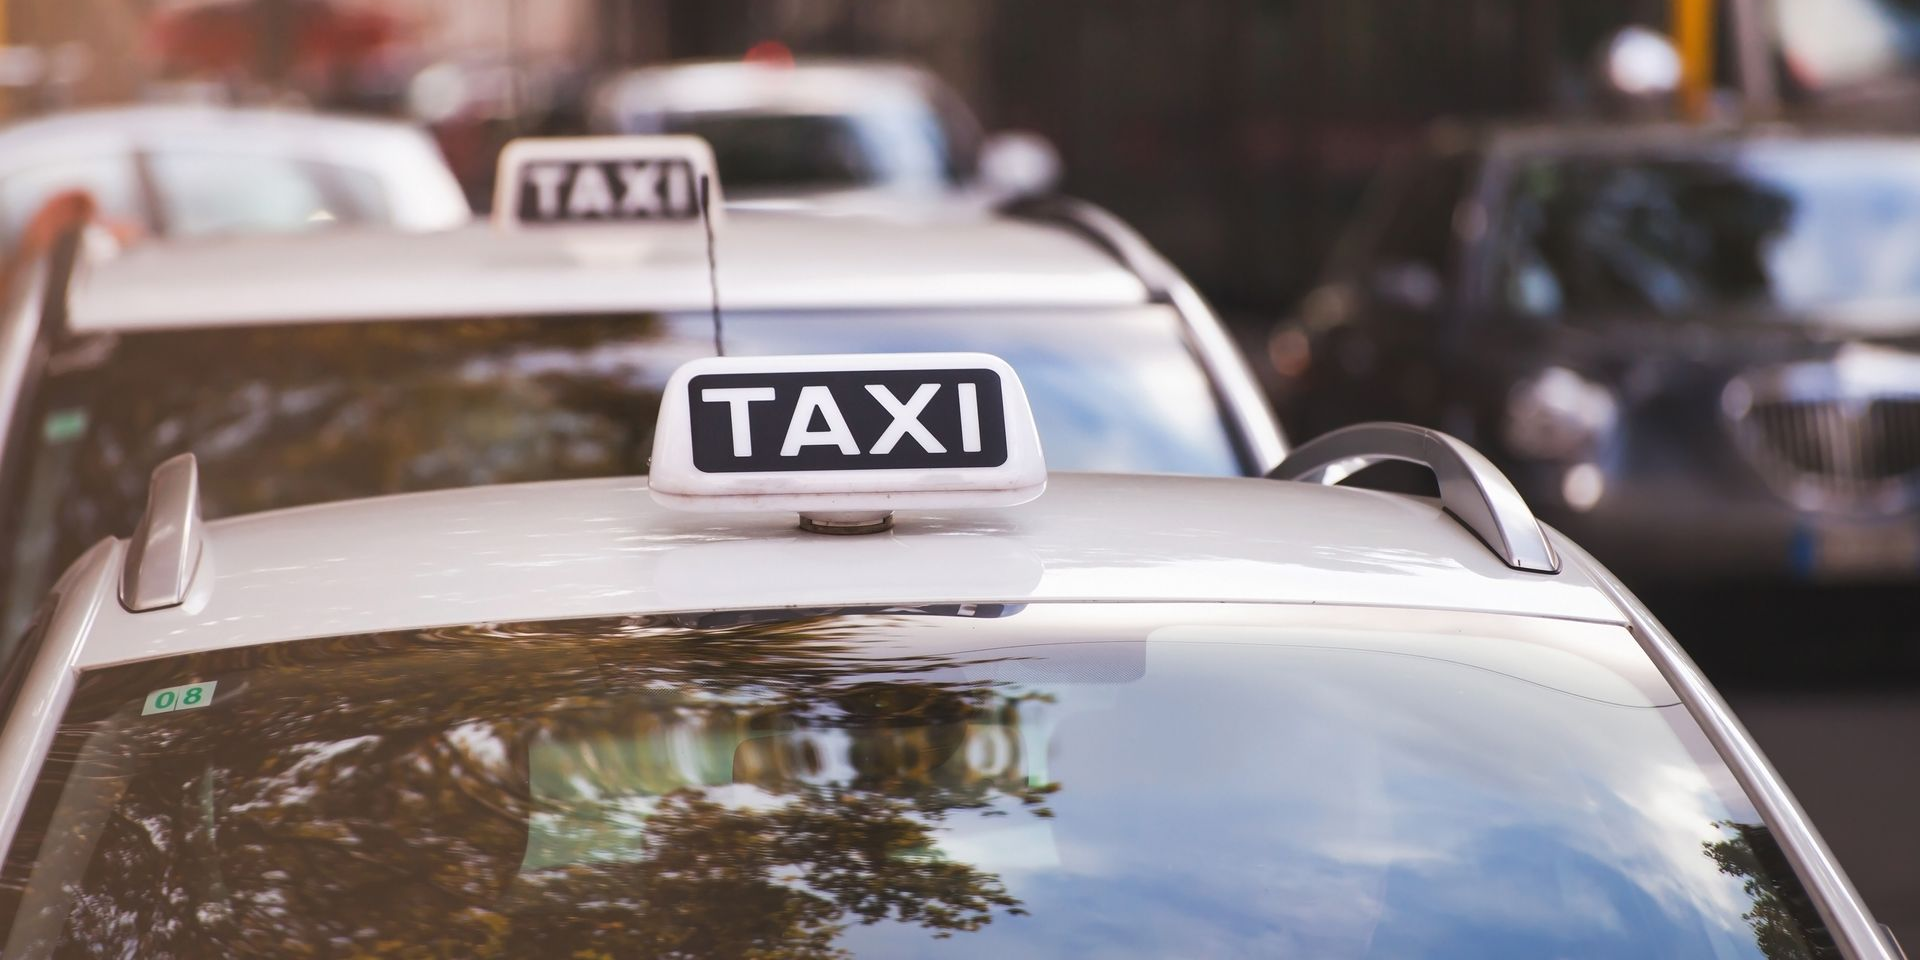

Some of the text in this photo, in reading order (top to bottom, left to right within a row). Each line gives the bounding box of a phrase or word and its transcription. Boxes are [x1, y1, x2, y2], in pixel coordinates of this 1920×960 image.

[526, 163, 691, 215] TAXI
[701, 382, 981, 457] TAXI
[154, 687, 203, 709] 08
